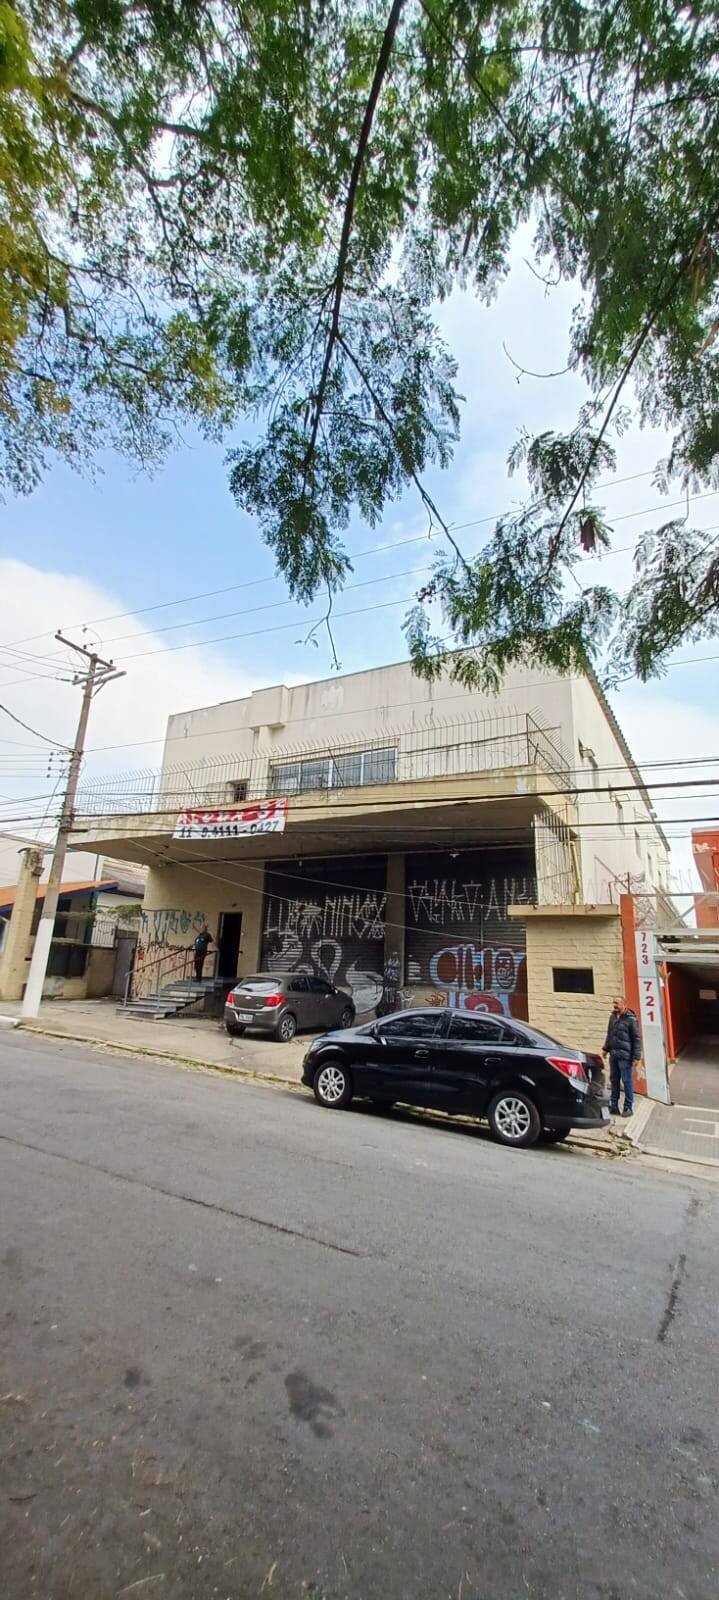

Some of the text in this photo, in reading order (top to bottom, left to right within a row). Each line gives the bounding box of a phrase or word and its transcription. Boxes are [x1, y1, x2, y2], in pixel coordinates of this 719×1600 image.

[179, 826, 192, 838] 11
[641, 932, 649, 965] 723
[643, 981, 655, 1022] 721
